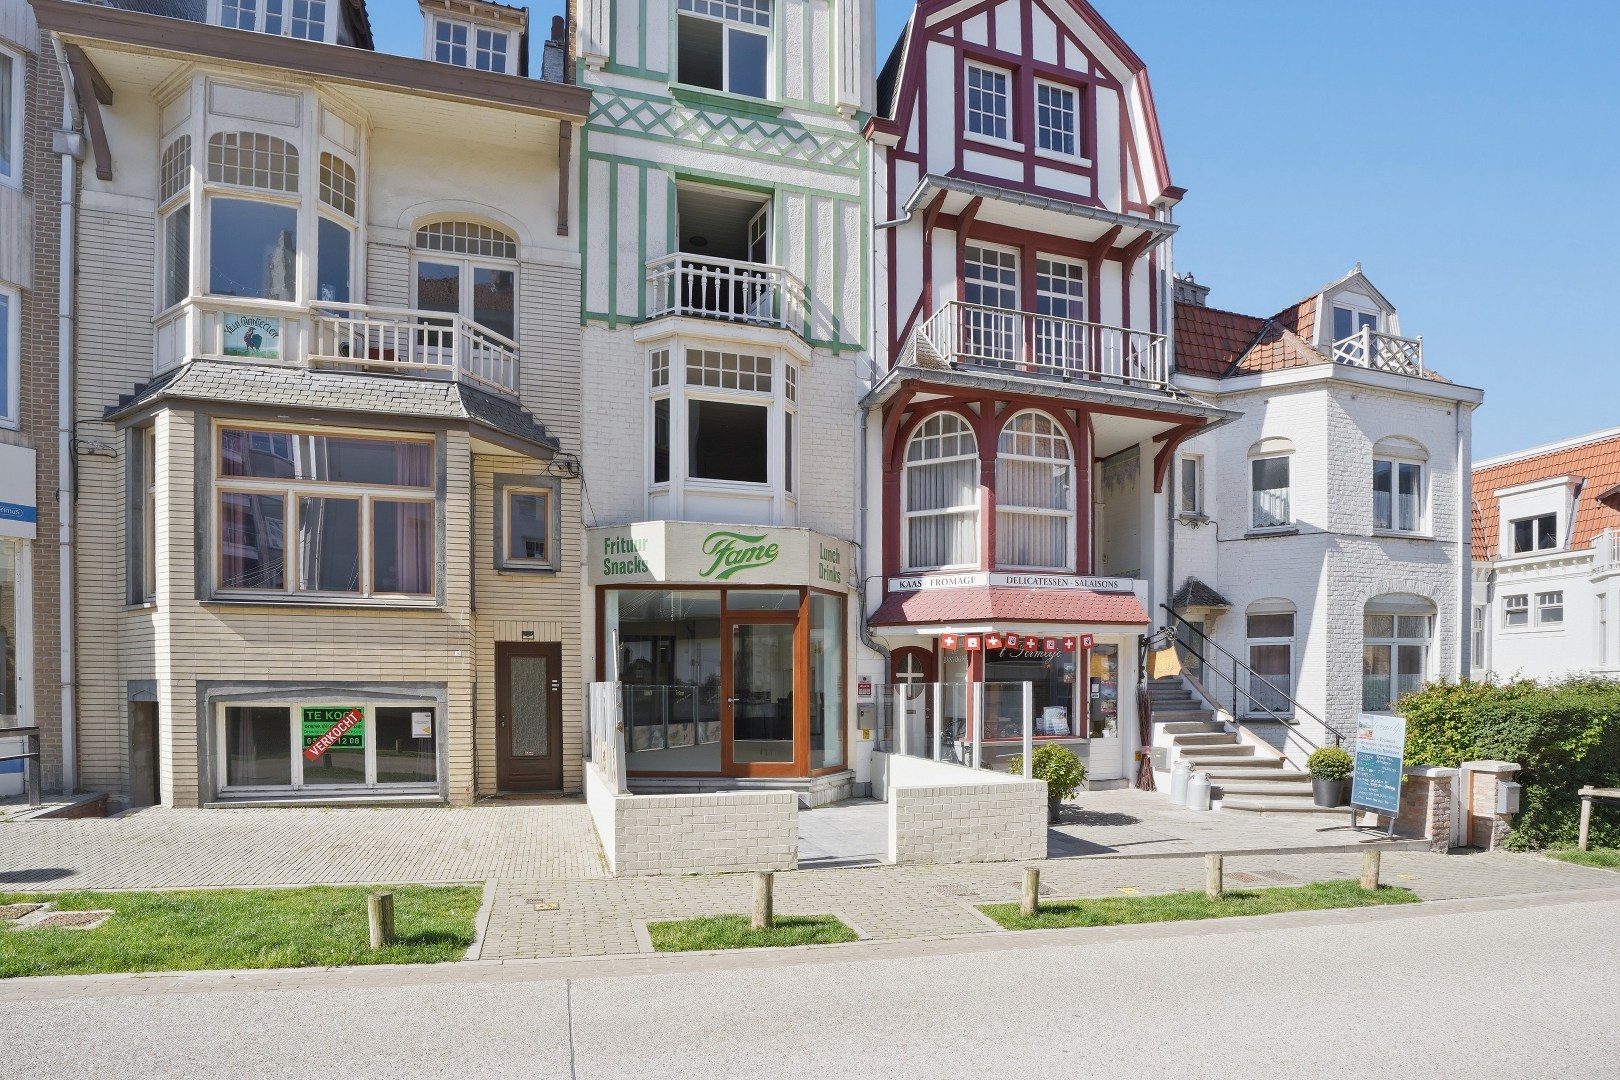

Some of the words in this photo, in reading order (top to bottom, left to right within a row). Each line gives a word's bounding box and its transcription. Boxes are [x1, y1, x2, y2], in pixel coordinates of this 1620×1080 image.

[0, 507, 20, 516] rimus
[604, 536, 648, 555] Frituur
[699, 531, 779, 580] Fame
[819, 542, 841, 565] Lunch
[603, 555, 649, 576] Snacks
[818, 562, 841, 584] Drinks
[899, 580, 922, 589] KAAS
[930, 576, 977, 587] FROMAGE
[1006, 576, 1068, 587] DELICATESSEN
[1075, 579, 1119, 589] SALAISONS
[306, 711, 321, 720] TE
[325, 711, 350, 720] KO
[308, 711, 358, 756] VERKOCHT
